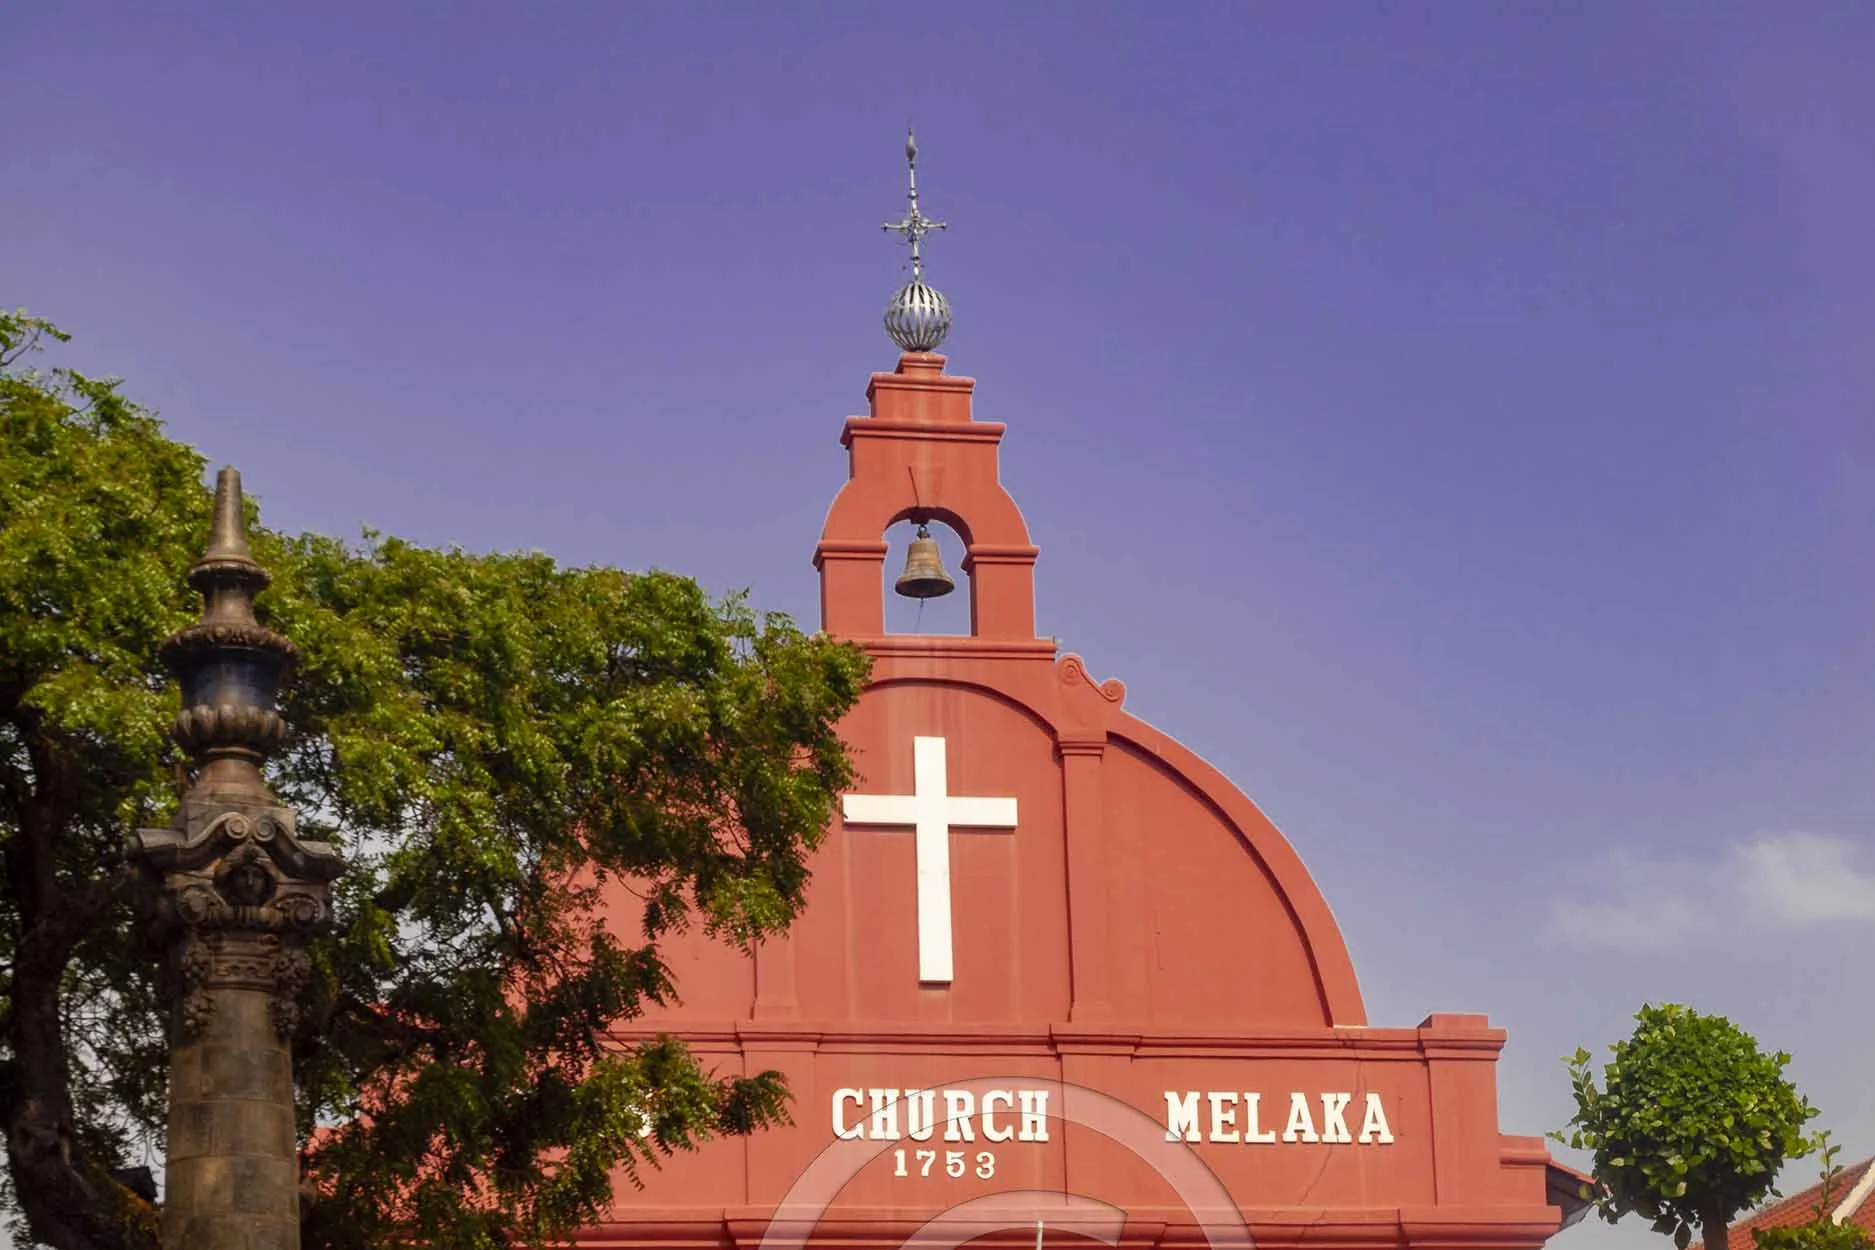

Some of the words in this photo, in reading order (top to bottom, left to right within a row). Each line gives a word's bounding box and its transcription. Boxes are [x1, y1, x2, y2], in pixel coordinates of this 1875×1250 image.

[832, 1087, 1050, 1142] CHURCH
[1164, 1091, 1395, 1144] MELAKA
[893, 1148, 996, 1179] 1753
